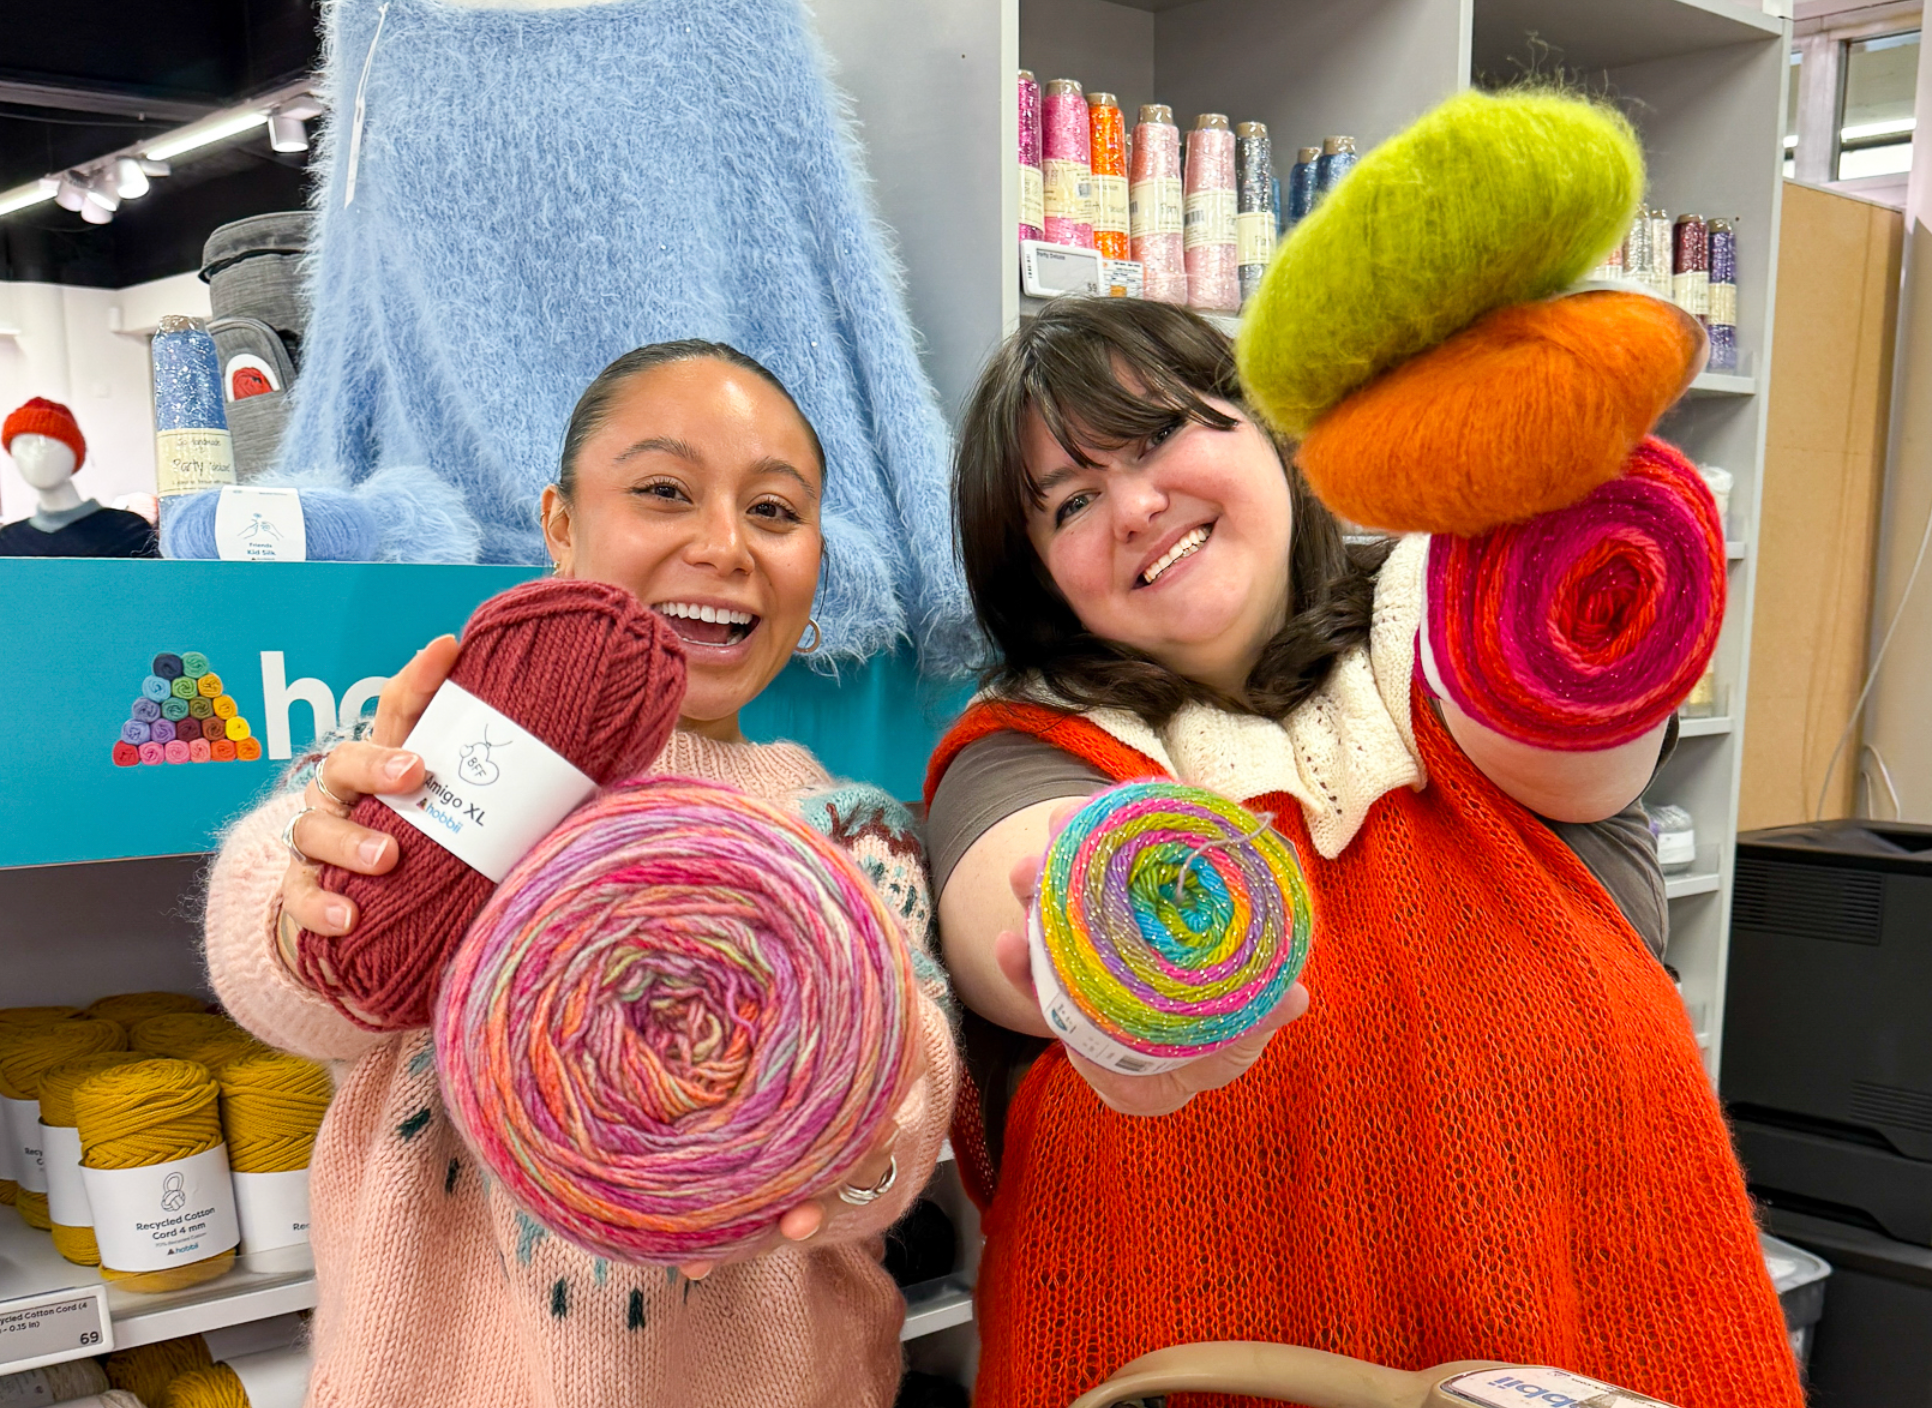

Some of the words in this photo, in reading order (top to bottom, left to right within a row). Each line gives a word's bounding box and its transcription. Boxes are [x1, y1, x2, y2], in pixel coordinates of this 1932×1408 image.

[173, 458, 204, 477] Party
[467, 757, 487, 778] BFF
[424, 775, 463, 809] Amigo
[463, 802, 486, 827] XL
[425, 802, 463, 834] hobbii
[136, 1215, 183, 1231] Recycled
[184, 1206, 216, 1222] Cotton
[152, 1228, 178, 1240] Cord
[179, 1226, 187, 1235] 4
[188, 1221, 207, 1233] mm
[24, 1308, 55, 1320] Cotton
[56, 1304, 78, 1314] Cord
[78, 1301, 88, 1310] (4
[9, 1322, 27, 1333] 0.15
[80, 1330, 99, 1345] 69
